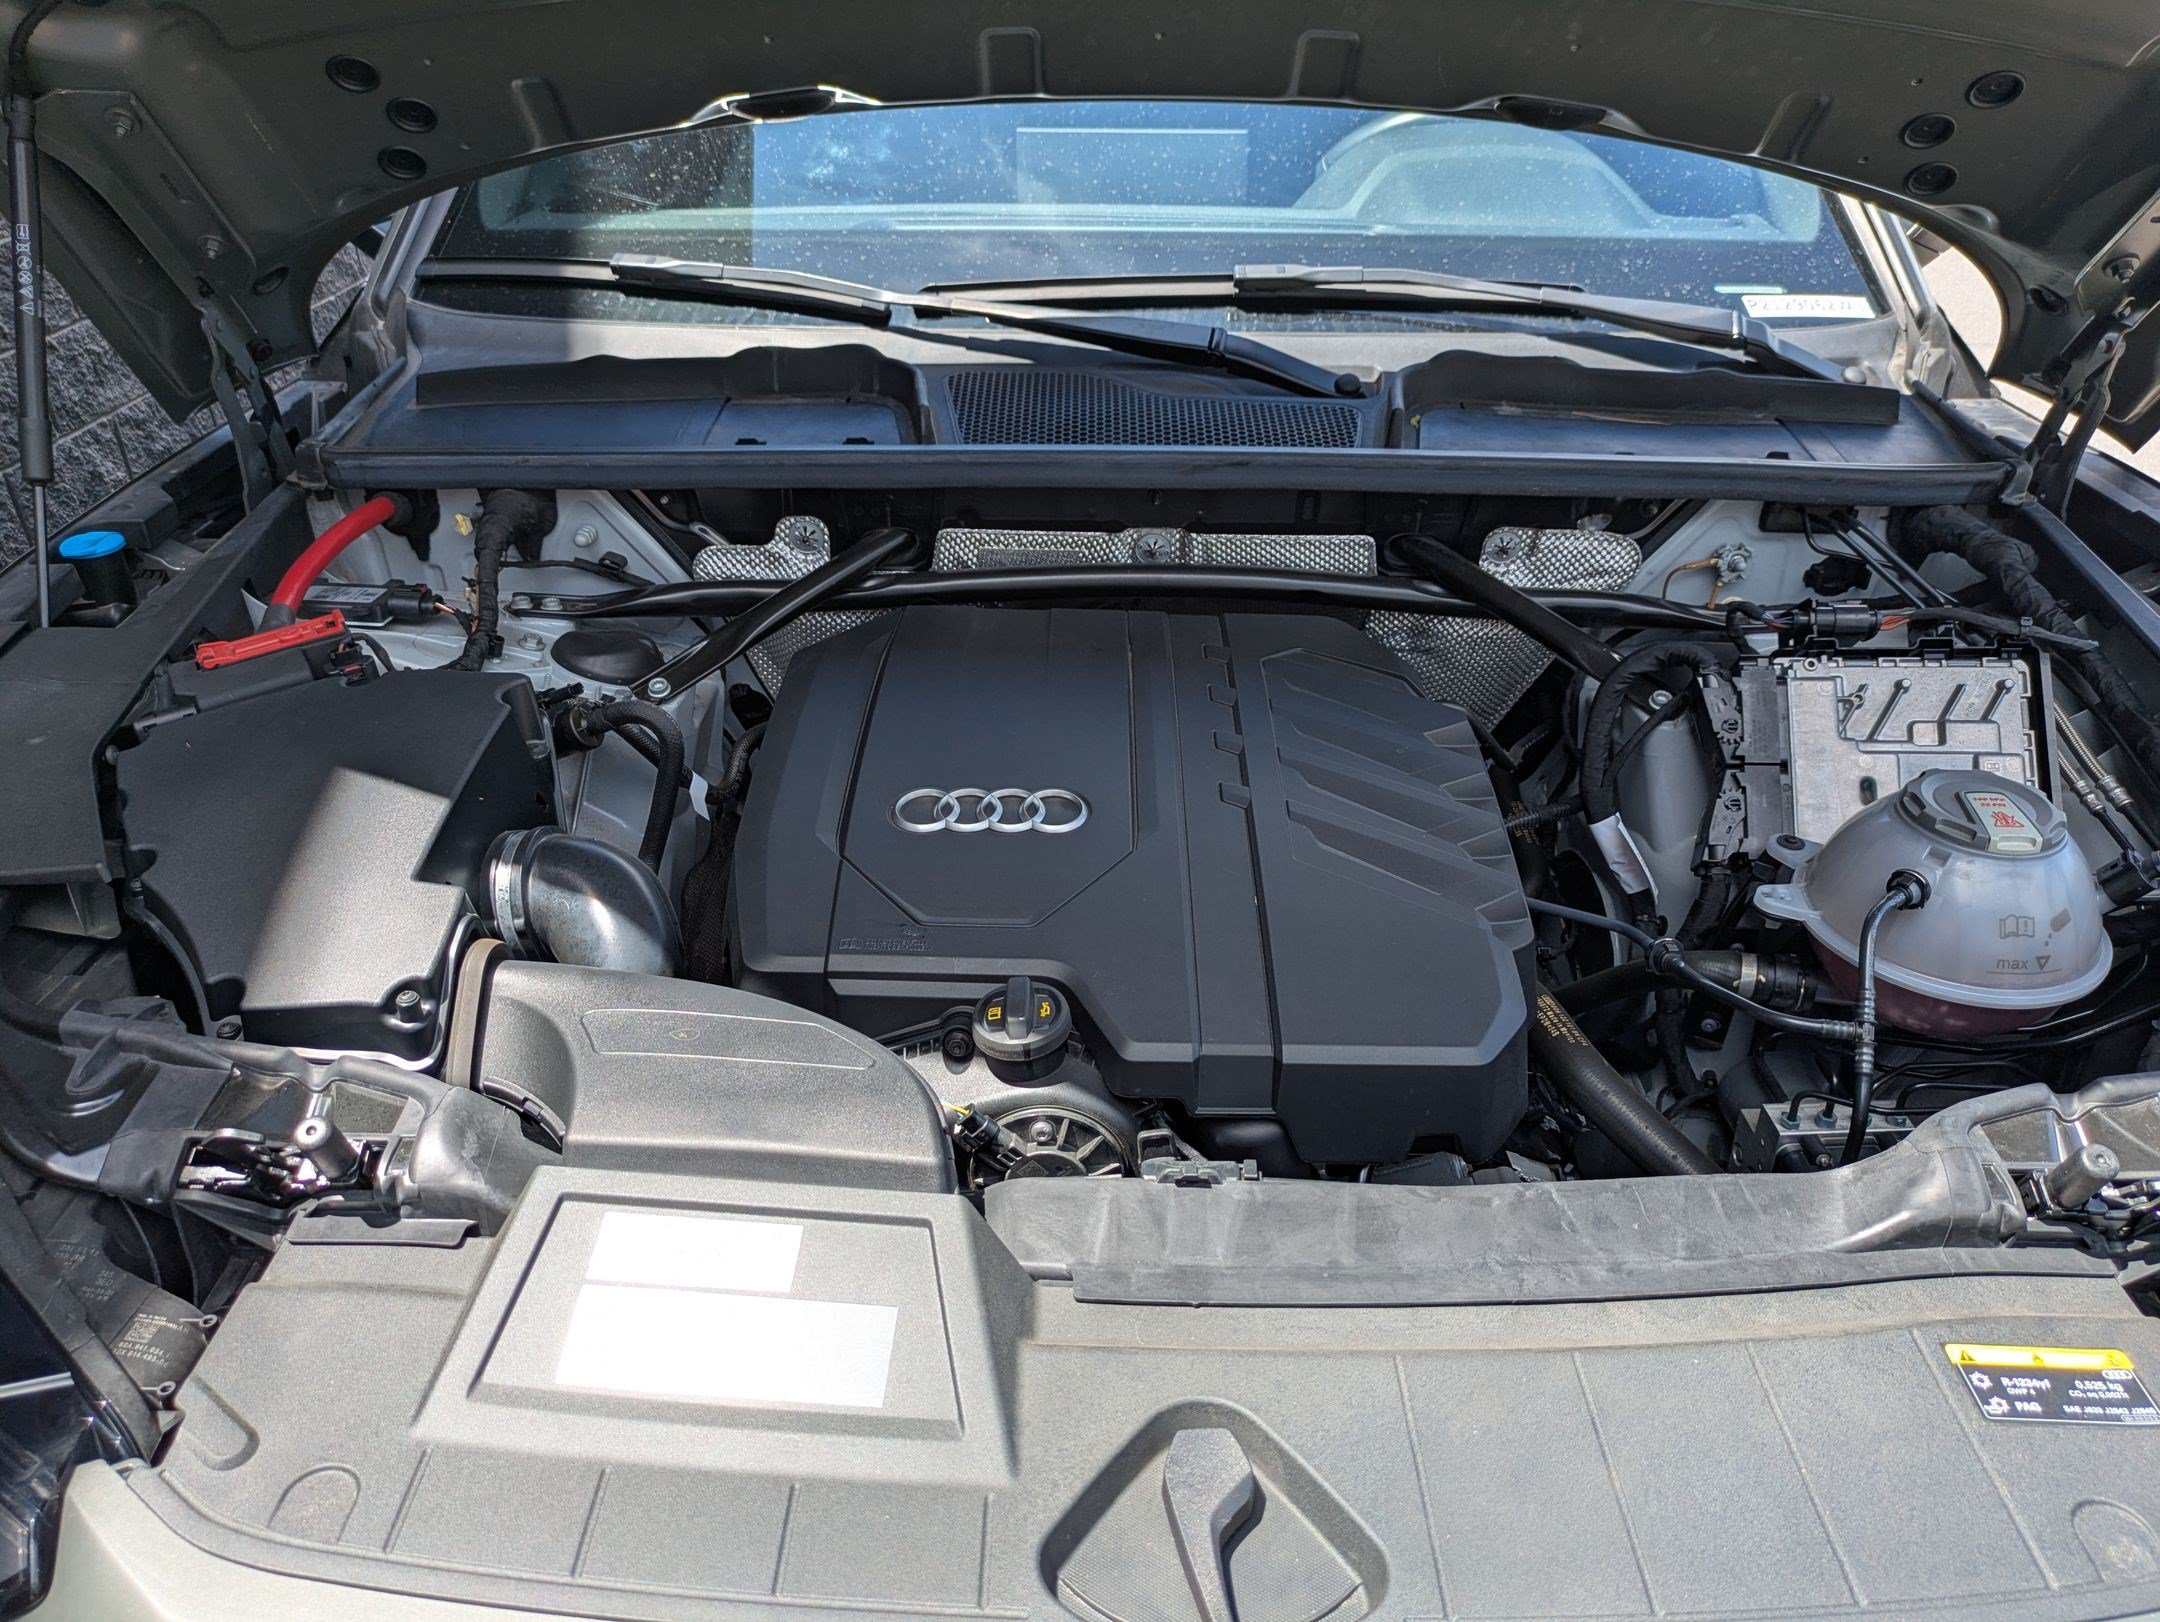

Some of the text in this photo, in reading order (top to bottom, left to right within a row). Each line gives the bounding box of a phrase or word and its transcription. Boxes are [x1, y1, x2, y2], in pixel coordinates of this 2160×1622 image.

[1996, 959, 2029, 970] max
[2006, 1387, 2028, 1395] GWP
[2106, 1381, 2125, 1392] kg
[2014, 1400, 2042, 1413] PAG
